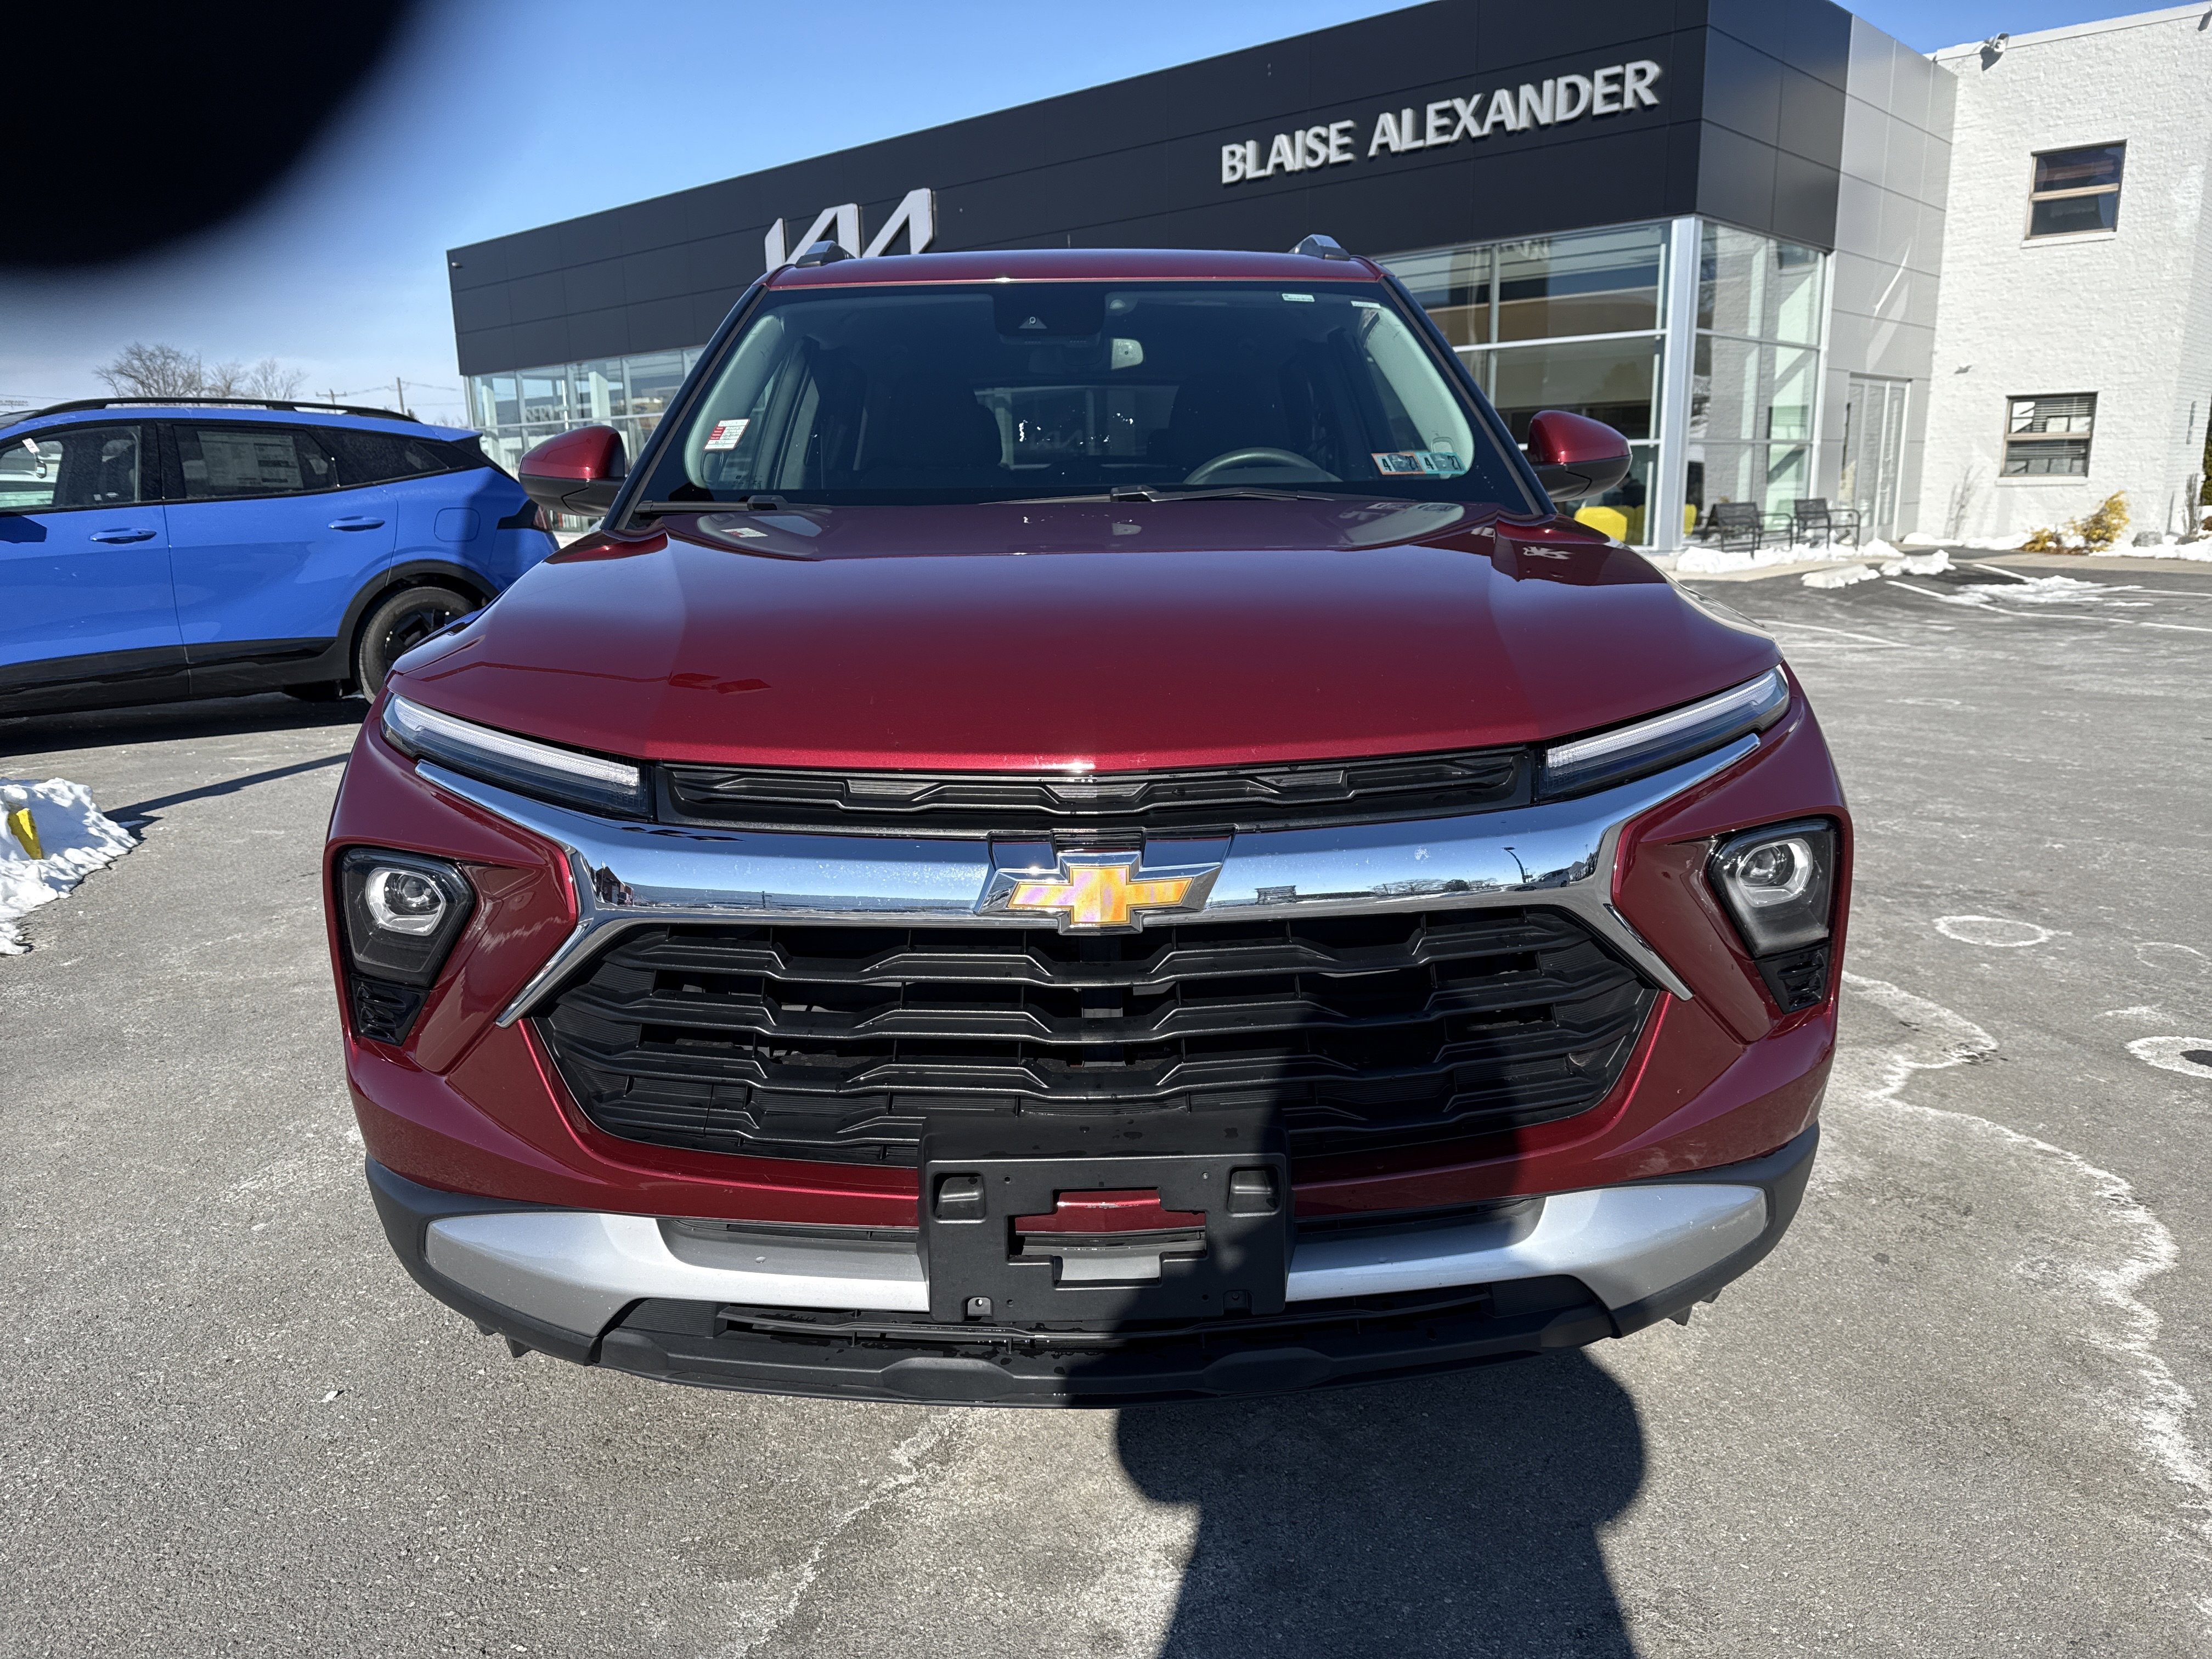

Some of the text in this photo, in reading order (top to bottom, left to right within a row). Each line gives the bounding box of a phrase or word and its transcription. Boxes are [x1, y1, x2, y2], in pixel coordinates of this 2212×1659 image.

[1222, 59, 1661, 185] BLAISE ALEXANDER
[1381, 458, 1392, 471] 4
[1424, 458, 1435, 470] 4
